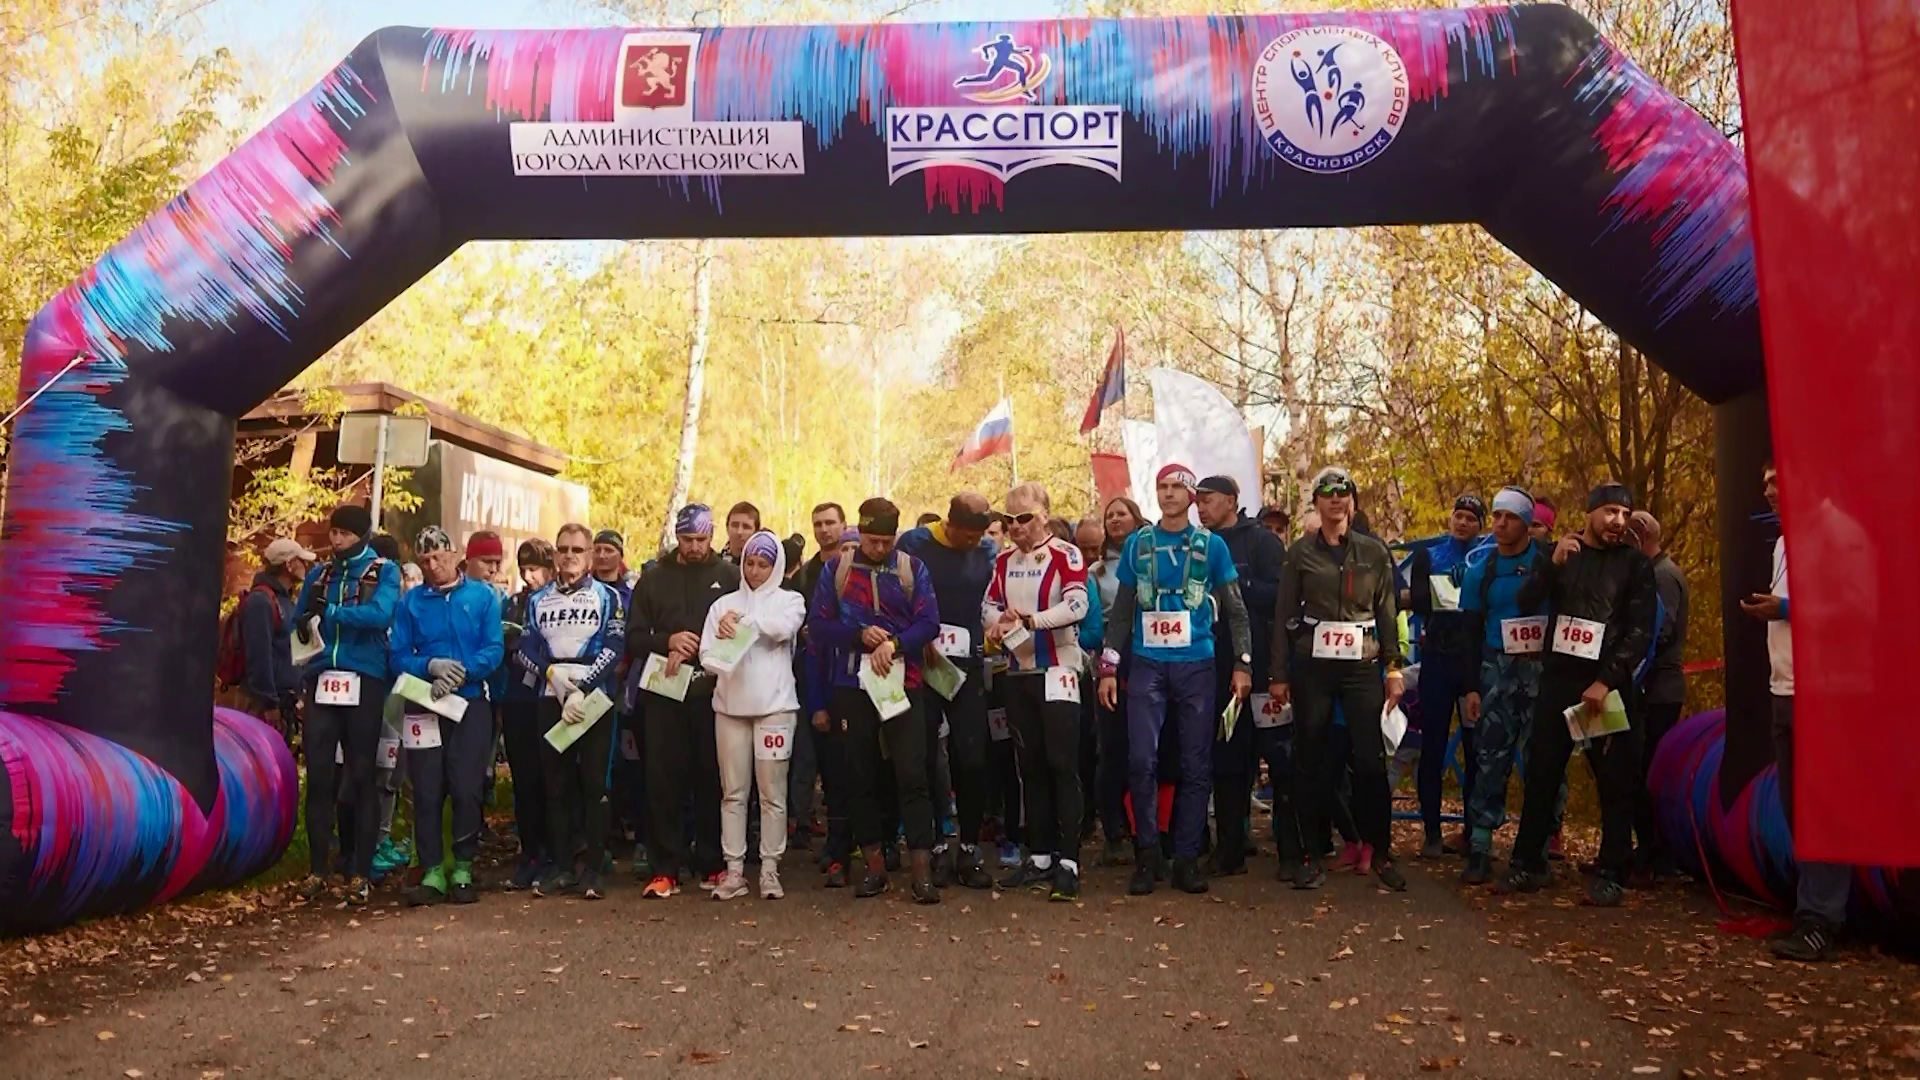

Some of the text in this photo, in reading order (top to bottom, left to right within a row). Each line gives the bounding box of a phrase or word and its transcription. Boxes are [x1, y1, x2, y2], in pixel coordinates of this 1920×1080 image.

[1255, 65, 1275, 130] ЦЕНТР
[1382, 49, 1405, 127] КЛУБОВ
[891, 111, 1119, 142] КРАССПОРТ
[543, 128, 770, 147] АДМИНИСТРАЦИЯ
[1274, 135, 1387, 168] КРАСНОЯРСК
[515, 152, 798, 172] ГОРОДА КРАСНОЯРСКА
[539, 608, 600, 624] ALEXIA
[1150, 620, 1182, 636] 184
[1509, 625, 1542, 641] 188
[1562, 626, 1593, 644] 189
[1322, 631, 1355, 647] 179
[322, 679, 350, 693] 181
[411, 723, 422, 737] 6
[764, 735, 785, 748] 60
